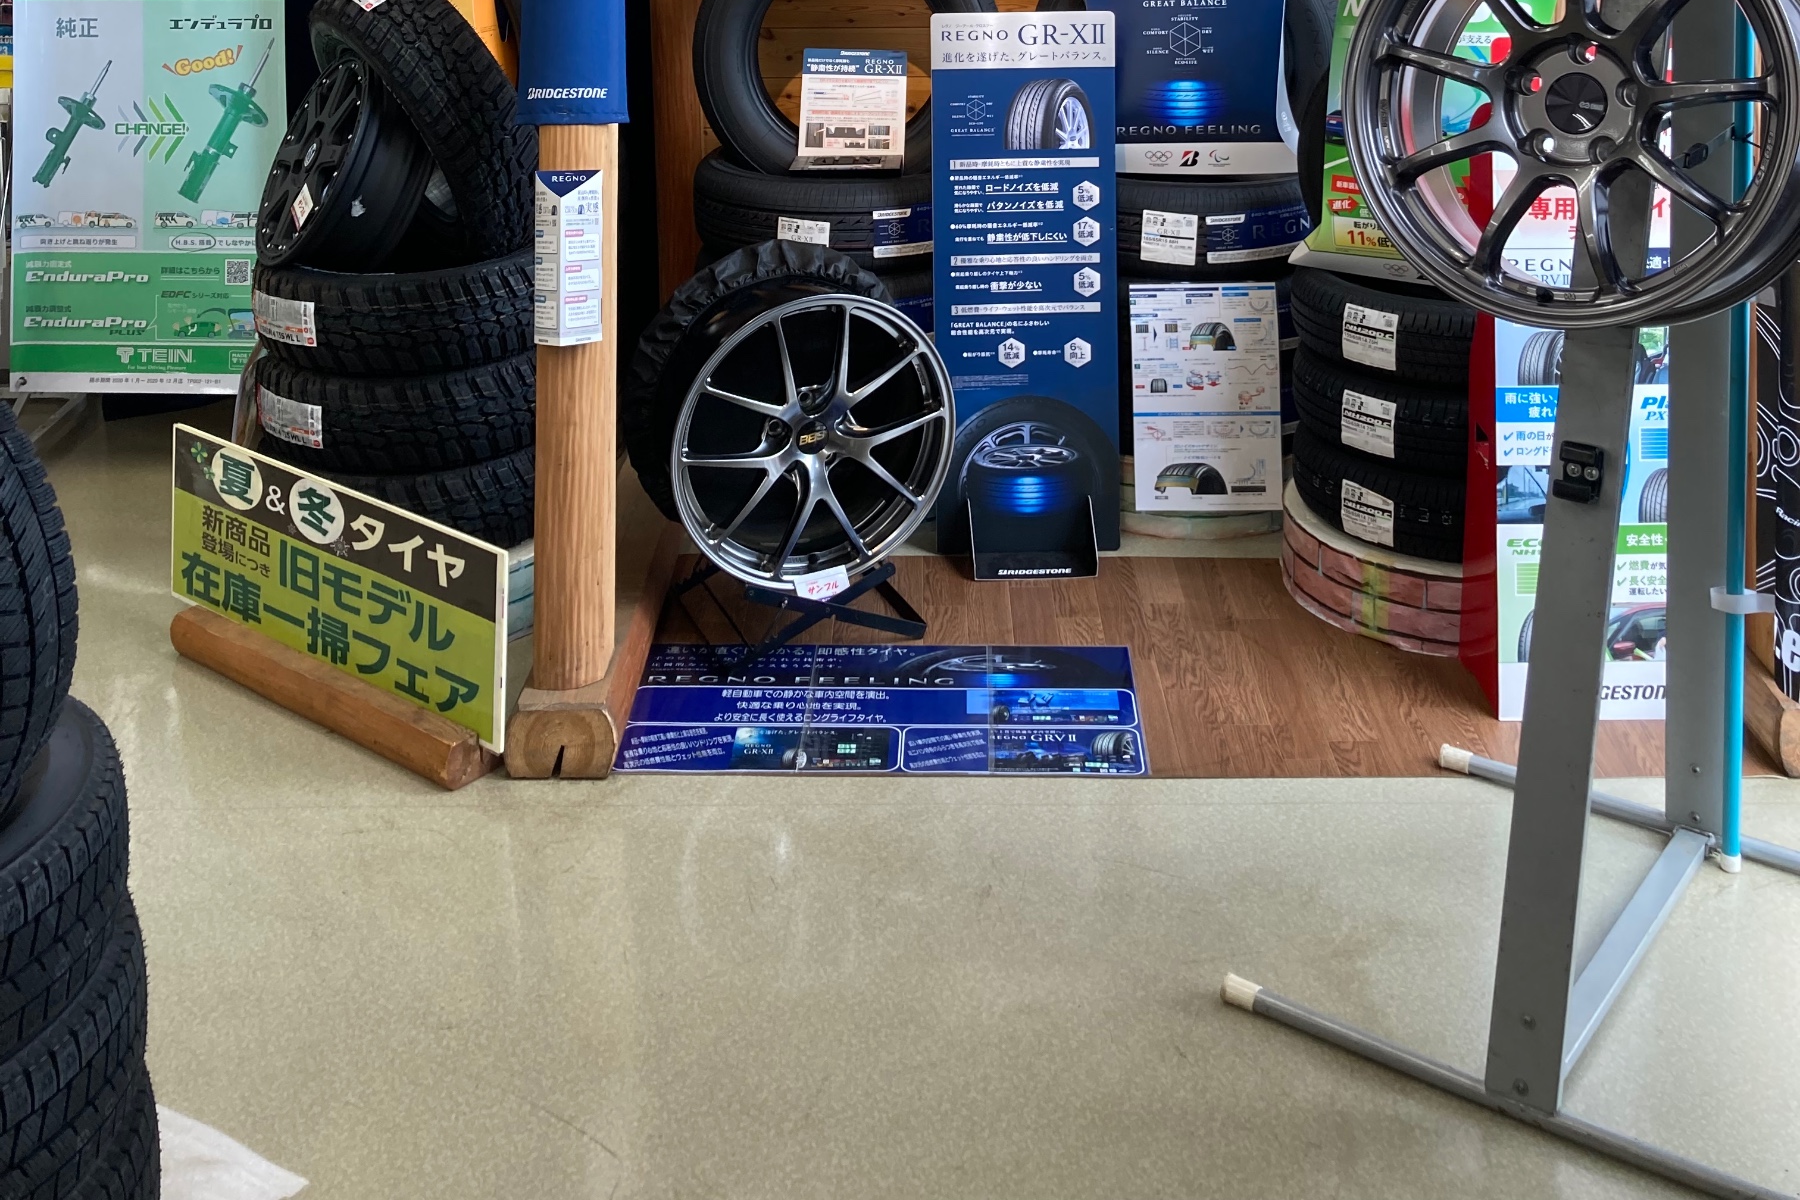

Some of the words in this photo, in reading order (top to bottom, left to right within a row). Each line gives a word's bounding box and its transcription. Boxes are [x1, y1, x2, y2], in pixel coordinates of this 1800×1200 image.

[1142, 0, 1176, 8] GREAT
[55, 17, 100, 40] 純正
[169, 15, 273, 31] エンデュラプロ
[941, 29, 1009, 42] REGNO
[174, 47, 236, 77] Good!
[942, 51, 1107, 63] 進化を遂げた、グレートバランス。
[527, 87, 609, 99] BRIDGESTONE
[114, 123, 187, 137] CHANGE!
[1117, 125, 1177, 136] REGNO
[1185, 124, 1262, 135] FEELING
[552, 173, 587, 183] REGNO
[986, 182, 1059, 192] ロードノイズを低減
[1077, 194, 1094, 202] 低減
[1332, 199, 1352, 209] 進化
[1528, 197, 1575, 220] 専用
[1077, 230, 1094, 239] 低減
[160, 266, 220, 275] 詳細はこちらから
[25, 271, 149, 284] EnduraPro
[1078, 281, 1095, 289] 低減
[160, 290, 192, 299] EDFC
[23, 316, 147, 329] EnduraPro
[1069, 342, 1083, 351] 6%
[137, 348, 193, 364] TEIN
[1003, 352, 1020, 360] 低減
[1069, 352, 1086, 360] 向上
[799, 431, 825, 446] BBS
[202, 505, 270, 557] 新商品
[201, 531, 271, 579] 登場につき
[1629, 560, 1667, 570] 燃費が気
[998, 567, 1072, 575] BRIDGESTONE
[1629, 575, 1667, 586] 長く安全
[808, 580, 839, 595] サンプル
[279, 540, 455, 651] 旧モデル
[181, 551, 480, 713] 在庫一掃フェア
[647, 675, 777, 684] REGNO
[794, 675, 955, 685] FEELING
[721, 689, 891, 700] 軽自動車での静かな車内空間を演出。
[736, 701, 863, 710] 快適な乗り心地を実現。
[713, 712, 888, 723] より安全に長く使えるロングライフタイヤ。
